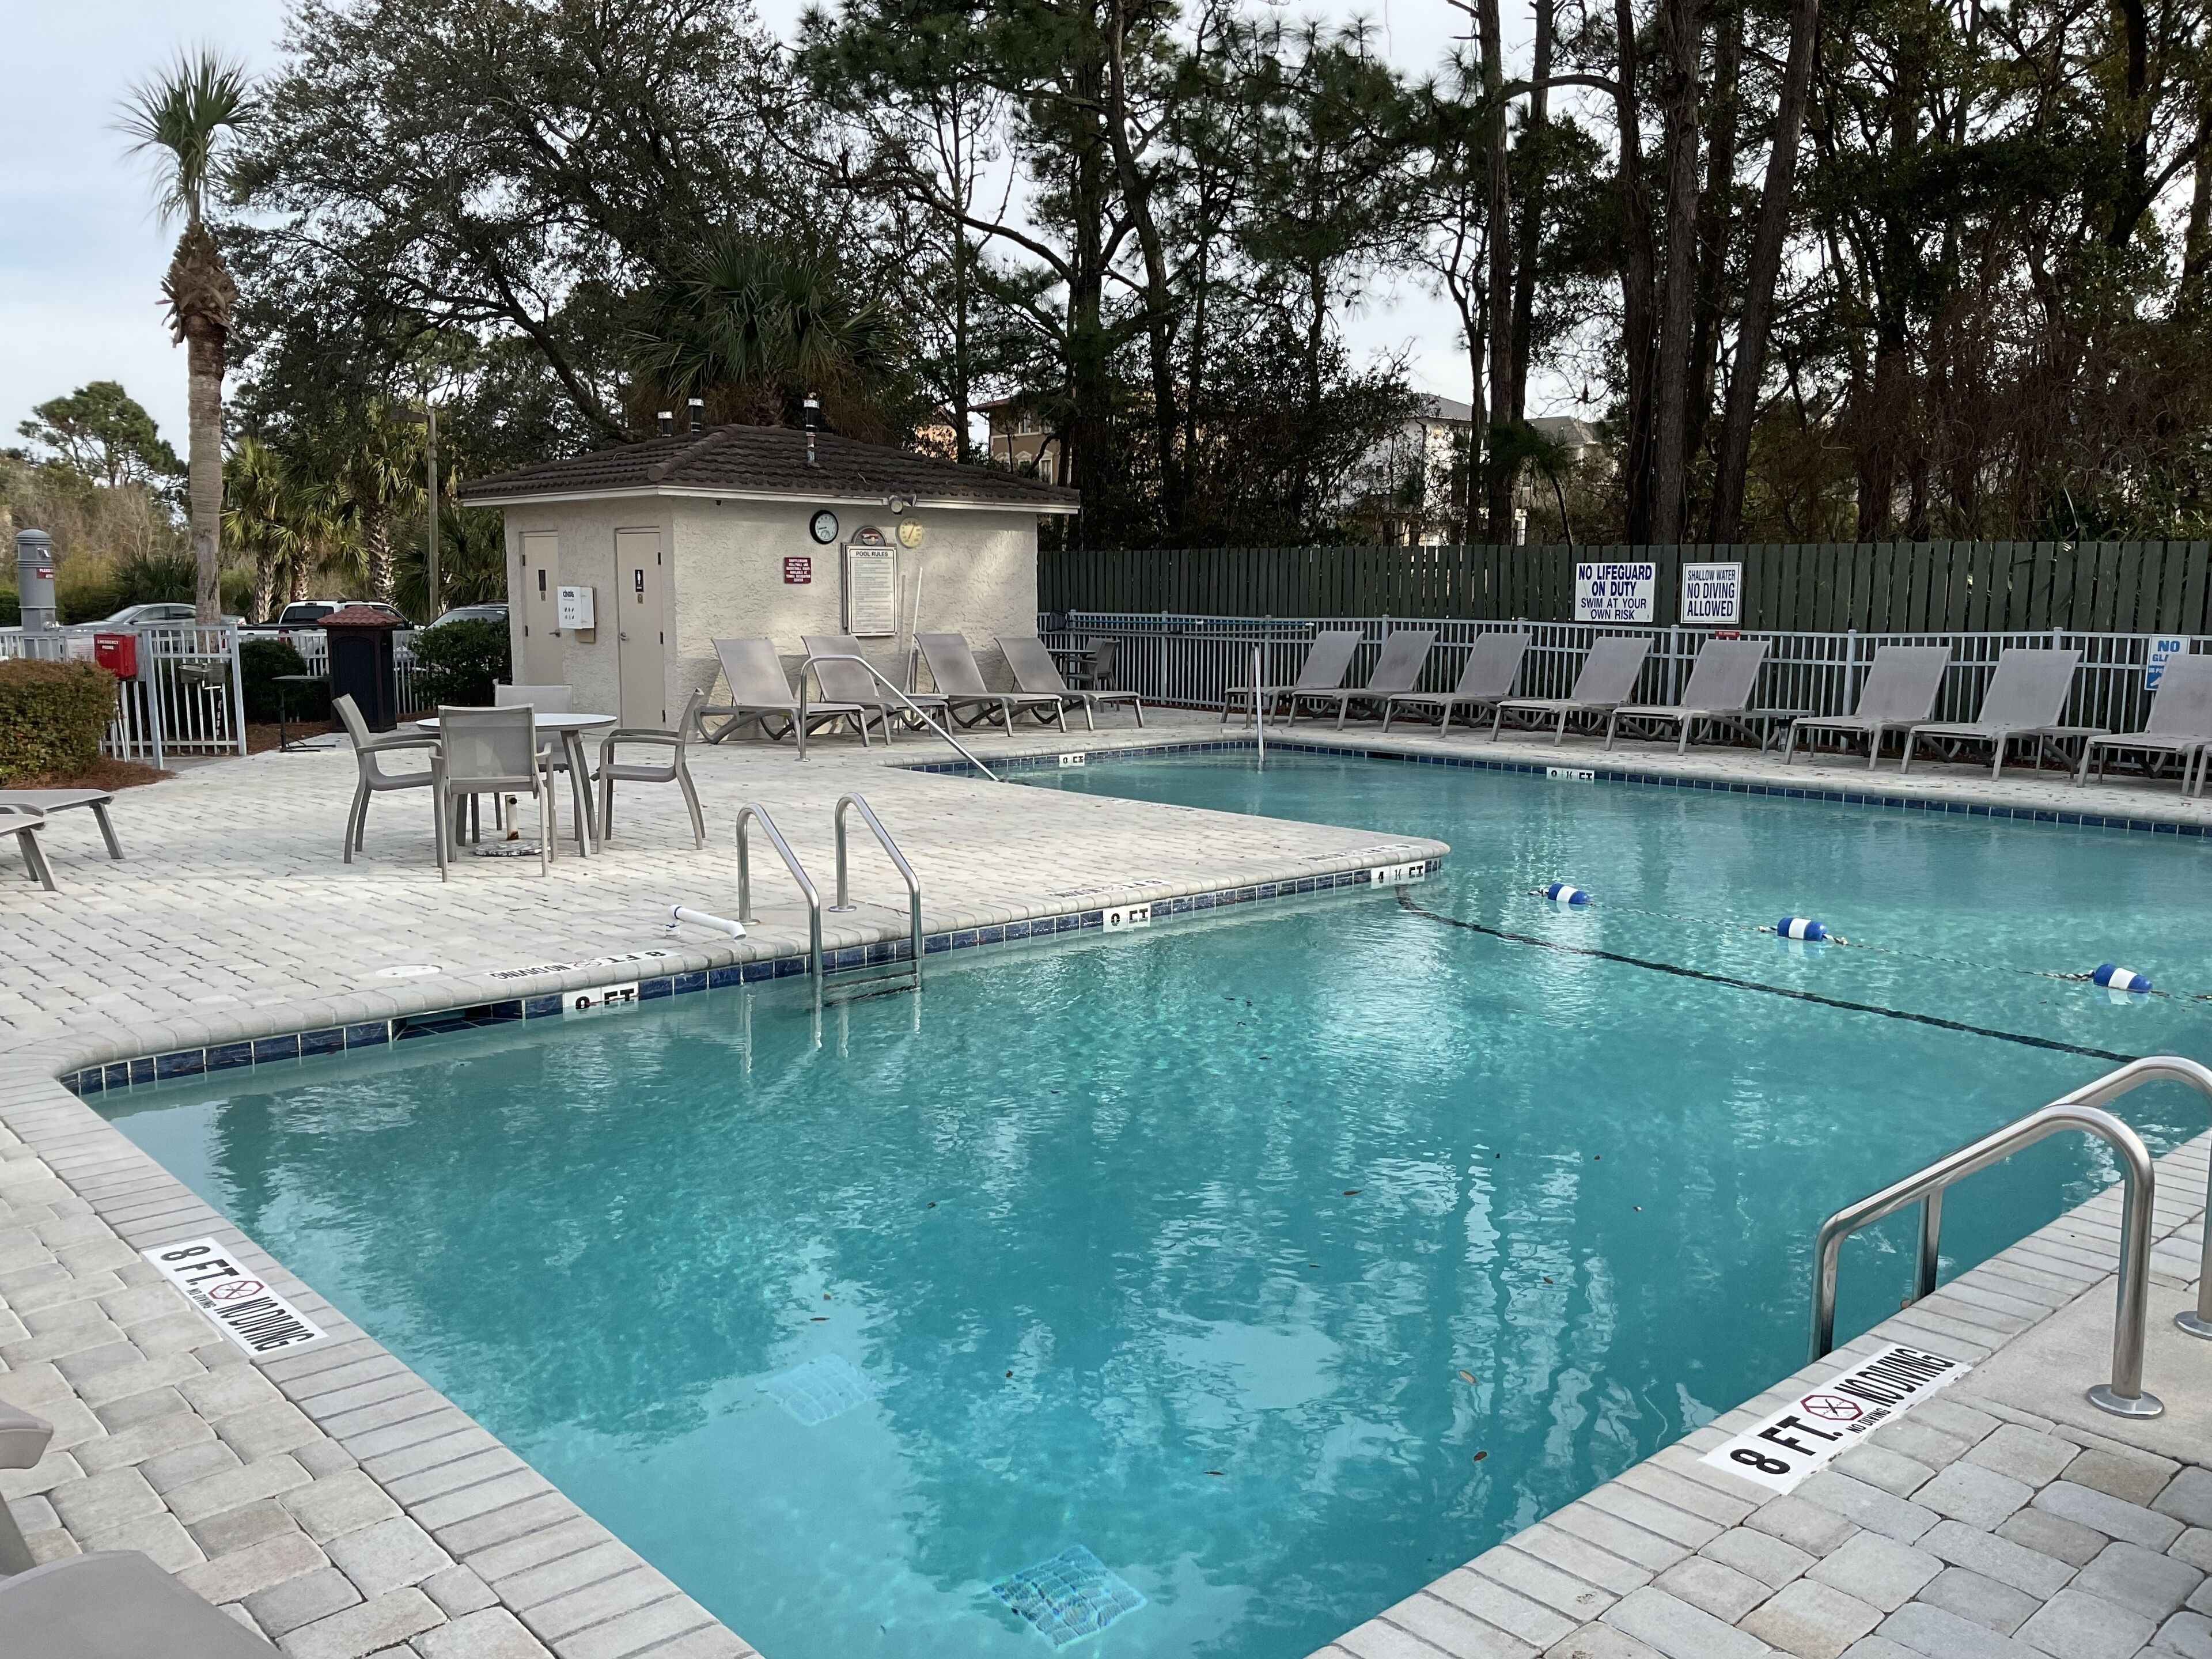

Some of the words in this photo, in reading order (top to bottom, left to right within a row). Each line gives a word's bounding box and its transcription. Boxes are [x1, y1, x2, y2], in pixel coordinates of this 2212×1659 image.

[1578, 565, 1592, 580] NO
[1597, 565, 1652, 580] LIFEGUARD
[1688, 570, 1715, 581] SHALLOW
[1717, 570, 1736, 581] WATER
[1592, 581, 1605, 596] ON
[1611, 581, 1637, 596] DUTY
[1687, 582, 1700, 599] NO
[1703, 582, 1735, 599] DIVING
[1581, 598, 1603, 608] SWIM
[1607, 598, 1618, 608] AT
[1623, 599, 1646, 609] YOUR
[1687, 600, 1733, 616] ALLOWED
[1591, 609, 1611, 619] OWN
[1615, 609, 1635, 620] RISK
[2157, 641, 2180, 652] NO
[490, 967, 548, 979] DIVING
[546, 964, 571, 973] NO
[160, 1245, 211, 1262] 8
[173, 1259, 240, 1286] FT.
[185, 1287, 202, 1297] NO
[192, 1294, 217, 1309] DIVING
[213, 1296, 279, 1319] NO
[227, 1308, 315, 1352] DIVING
[1855, 1348, 1956, 1393] DIVING
[1832, 1378, 1905, 1408] NO
[1845, 1424, 1866, 1434] NO
[1861, 1407, 1892, 1427] DIVING
[1756, 1415, 1843, 1456] FT.
[1730, 1448, 1790, 1475] 8
